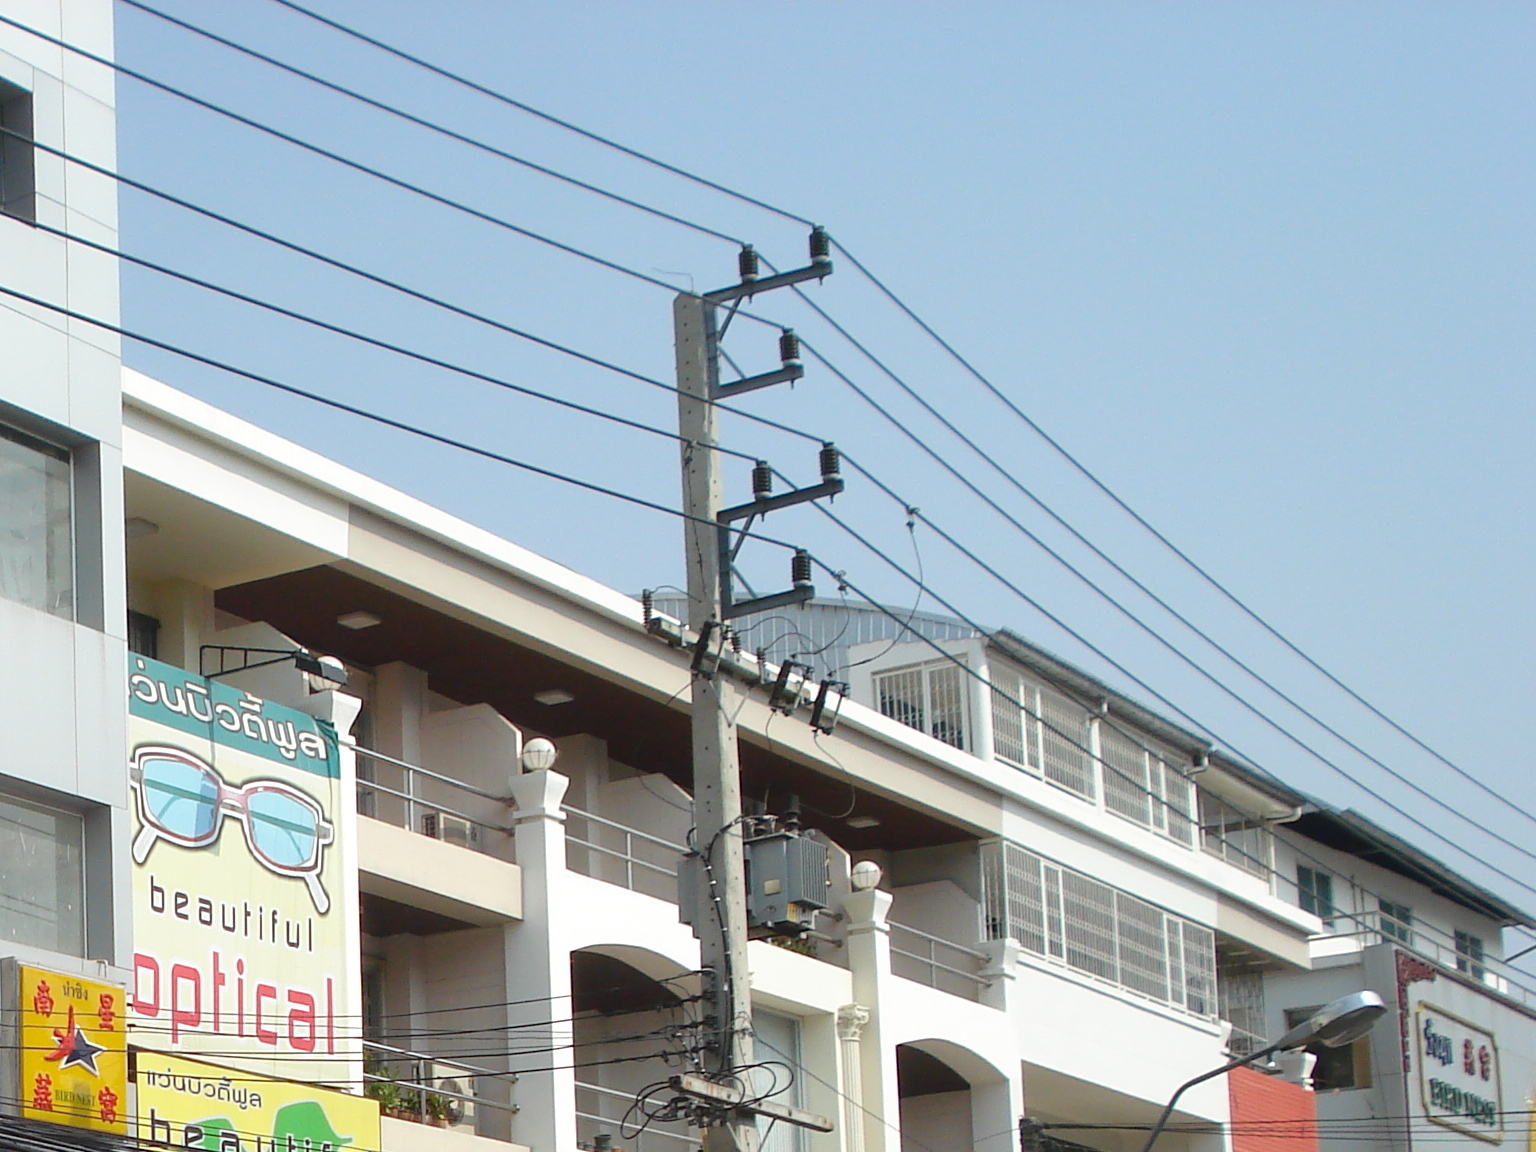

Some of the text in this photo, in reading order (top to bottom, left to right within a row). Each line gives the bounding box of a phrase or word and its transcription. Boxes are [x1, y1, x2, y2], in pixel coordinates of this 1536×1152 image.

[150, 874, 313, 952] beautiful
[34, 979, 54, 1018] 南
[99, 993, 116, 1031] 星
[132, 949, 335, 1056] optical
